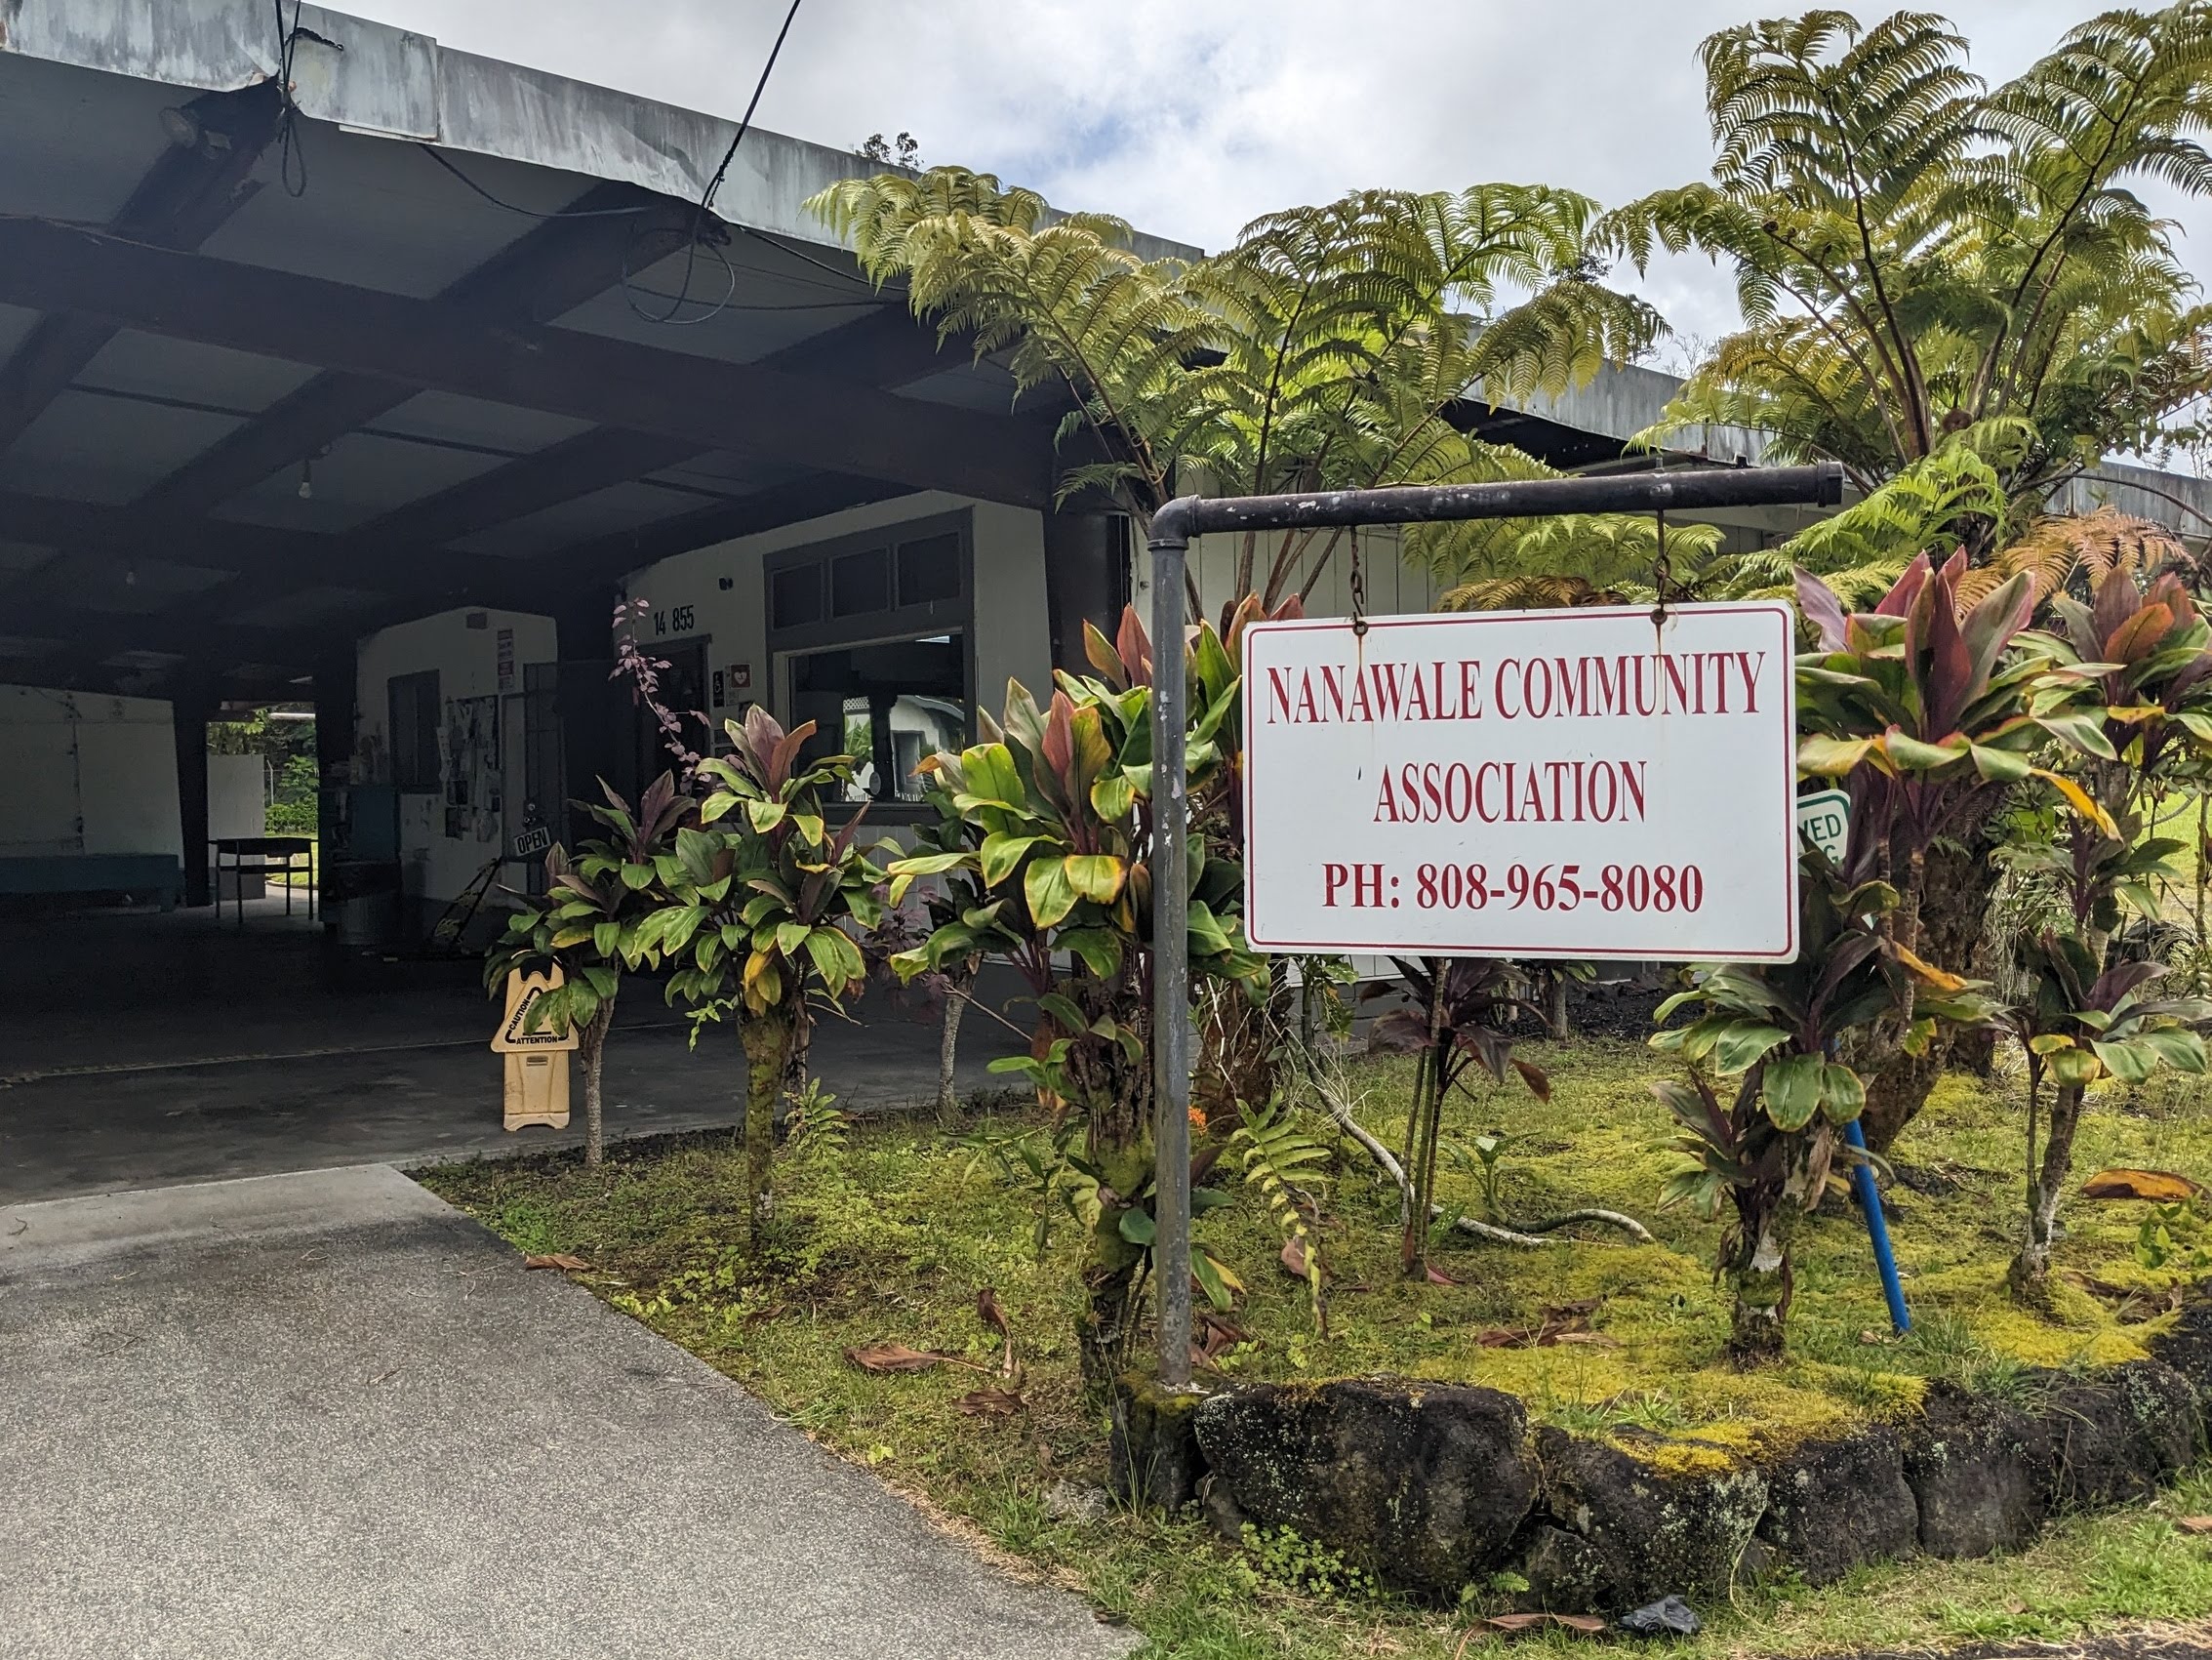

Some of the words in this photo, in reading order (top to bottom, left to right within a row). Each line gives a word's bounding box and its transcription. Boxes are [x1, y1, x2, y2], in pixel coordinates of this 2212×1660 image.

[653, 611, 666, 635] 14
[672, 605, 694, 631] 855
[1267, 661, 1482, 724] NANAWALE
[1495, 651, 1765, 719] COMMUNITY
[1373, 760, 1647, 824] ASSOCIATION
[516, 829, 547, 854] OPEN
[1322, 864, 1400, 909] PH:
[1417, 864, 1704, 912] 808-965-8080
[509, 997, 530, 1031] CAUTION
[516, 1035, 558, 1045] ATTENTION
